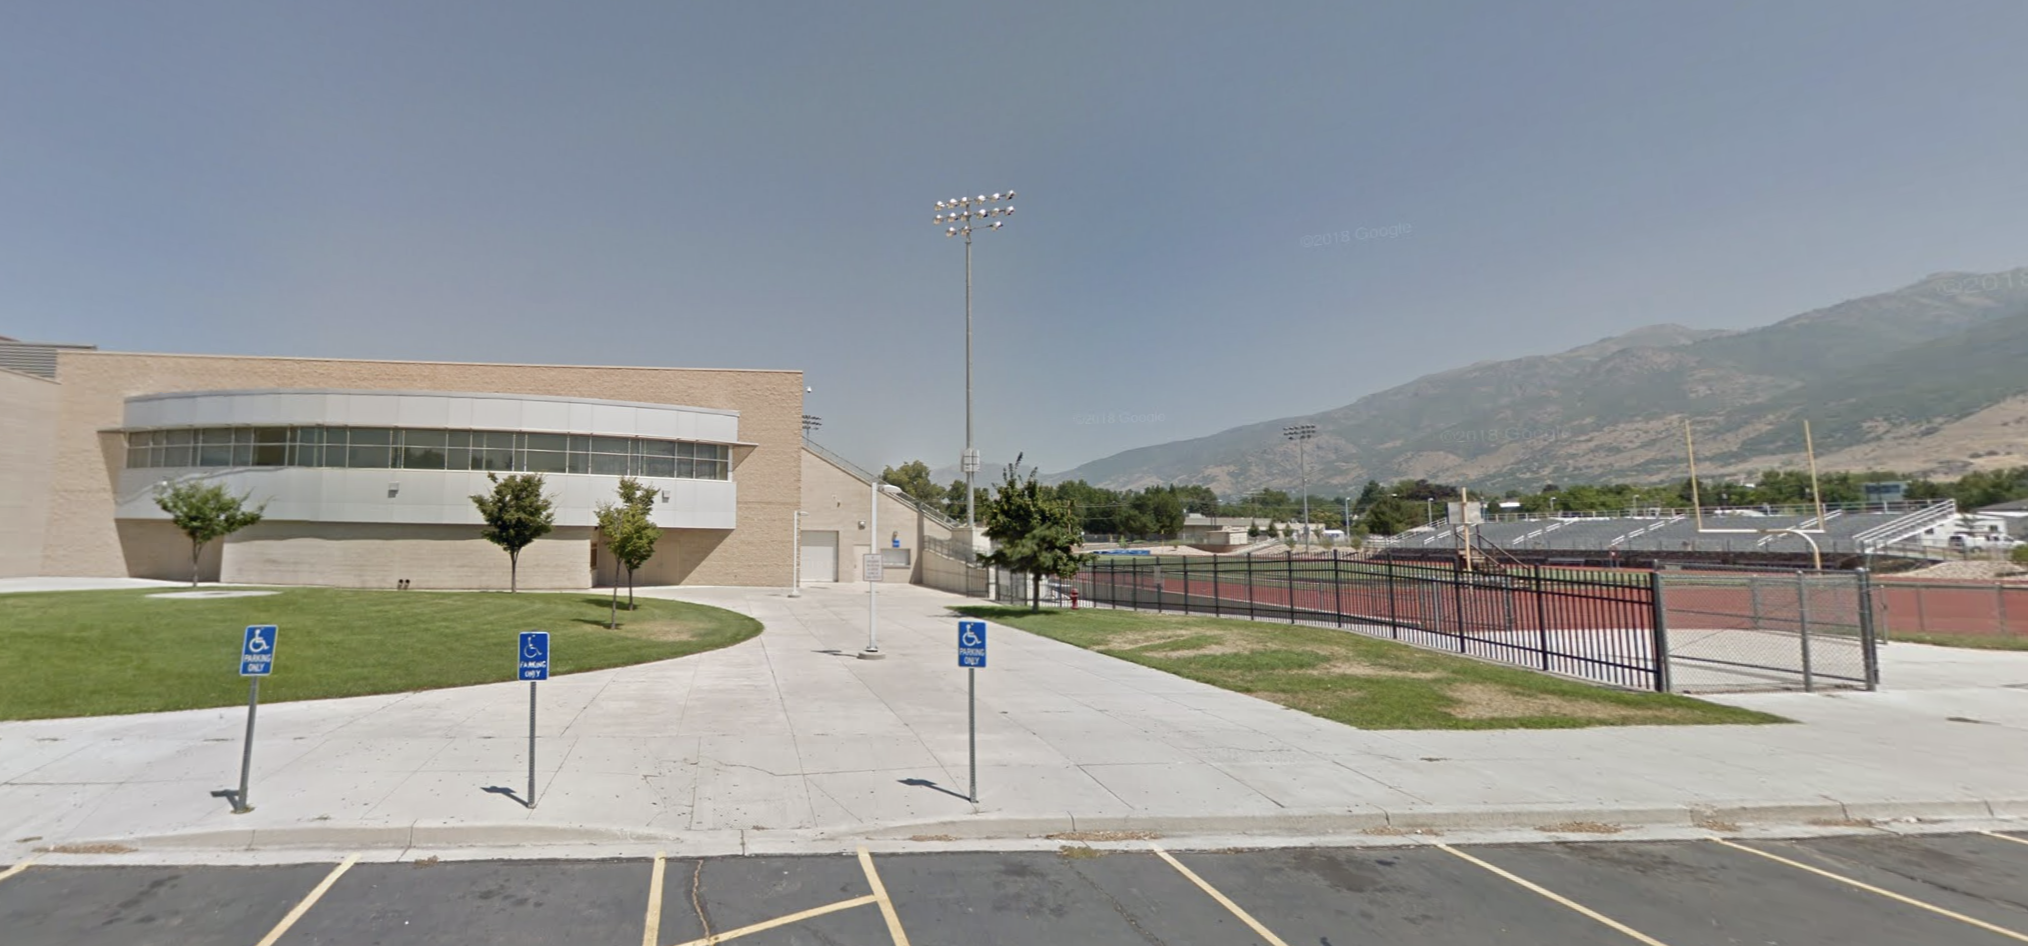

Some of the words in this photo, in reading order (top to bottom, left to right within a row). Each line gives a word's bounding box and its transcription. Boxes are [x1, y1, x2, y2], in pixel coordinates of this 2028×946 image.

[960, 647, 985, 656] PARKING
[243, 654, 271, 663] PARKING
[964, 656, 980, 665] ONLY
[248, 663, 266, 672] ONLY
[519, 660, 547, 668] PARKING
